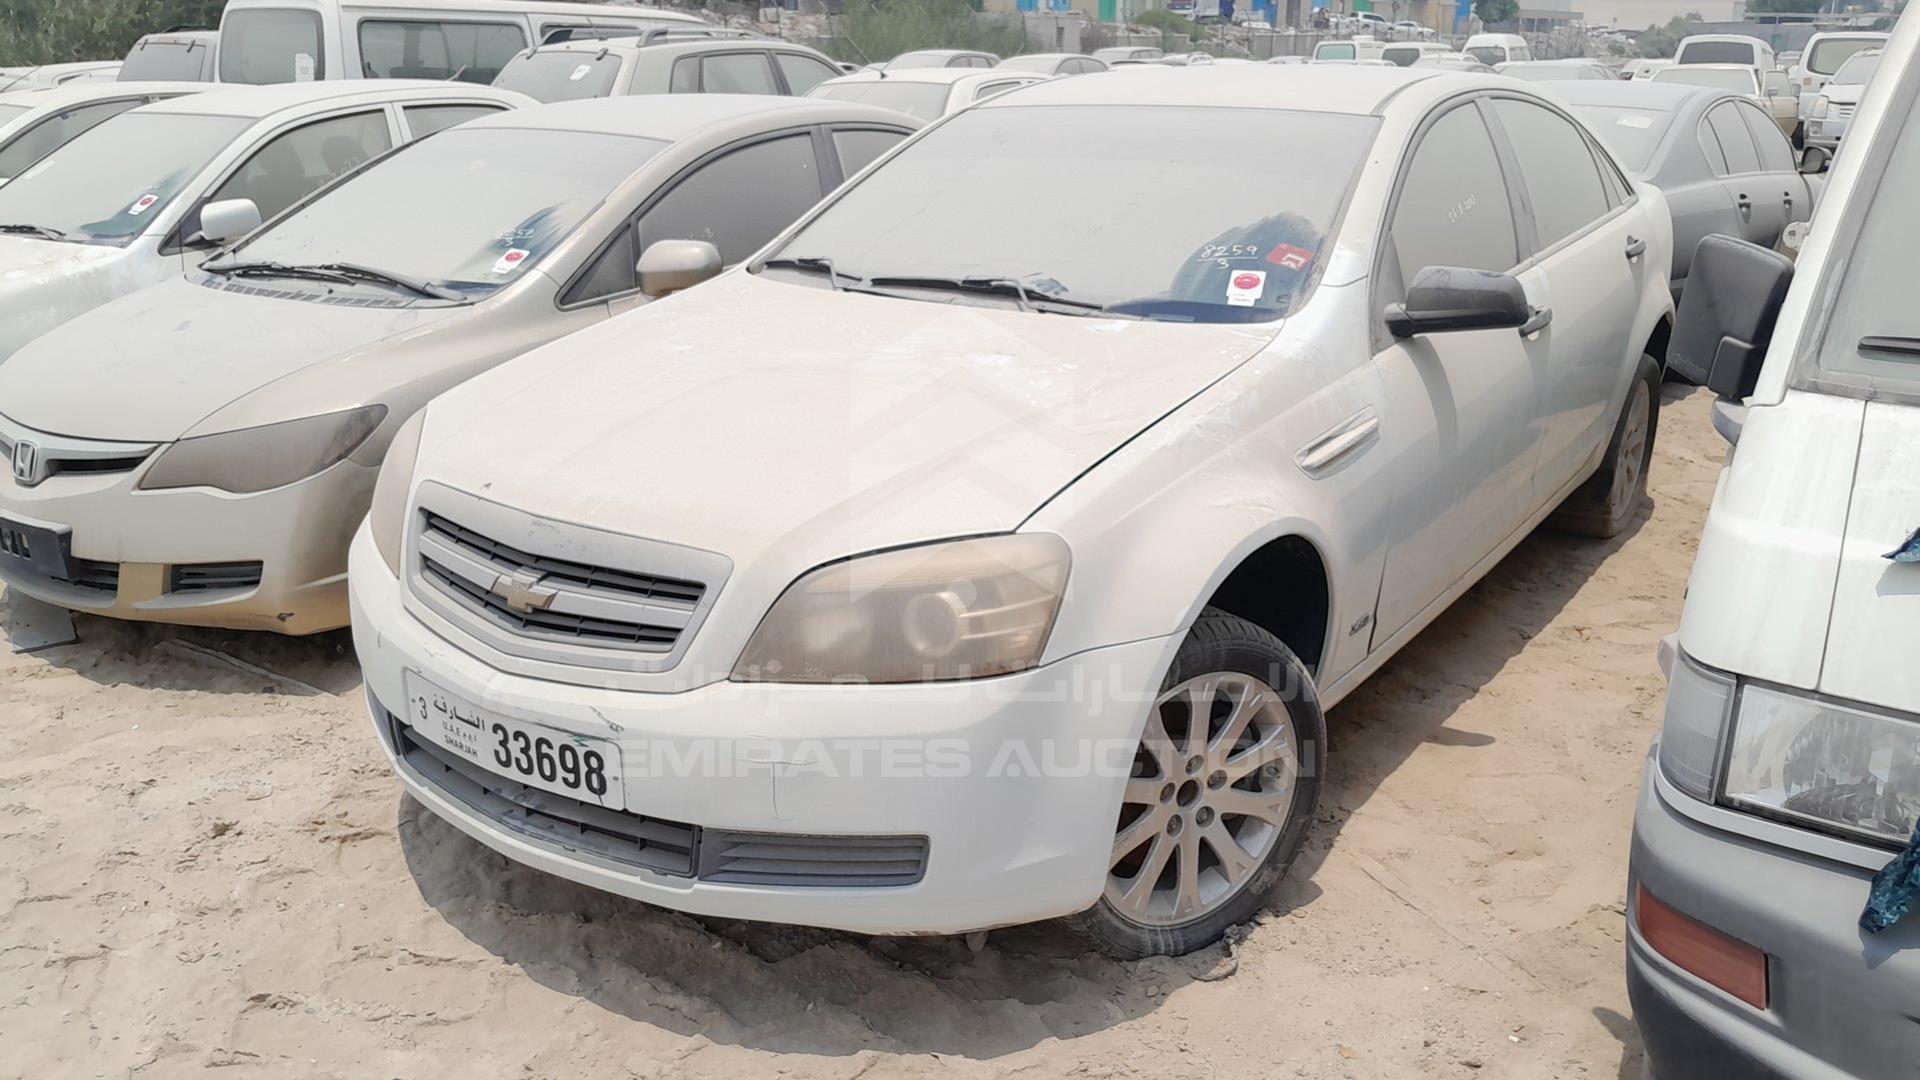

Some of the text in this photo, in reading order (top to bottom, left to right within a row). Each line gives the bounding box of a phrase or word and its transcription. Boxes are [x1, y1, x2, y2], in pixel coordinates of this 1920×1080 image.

[1200, 244, 1259, 259] 8259
[1216, 258, 1230, 270] 3
[418, 696, 428, 720] 3
[444, 734, 479, 758] SHARJAH
[492, 722, 608, 796] 33698
